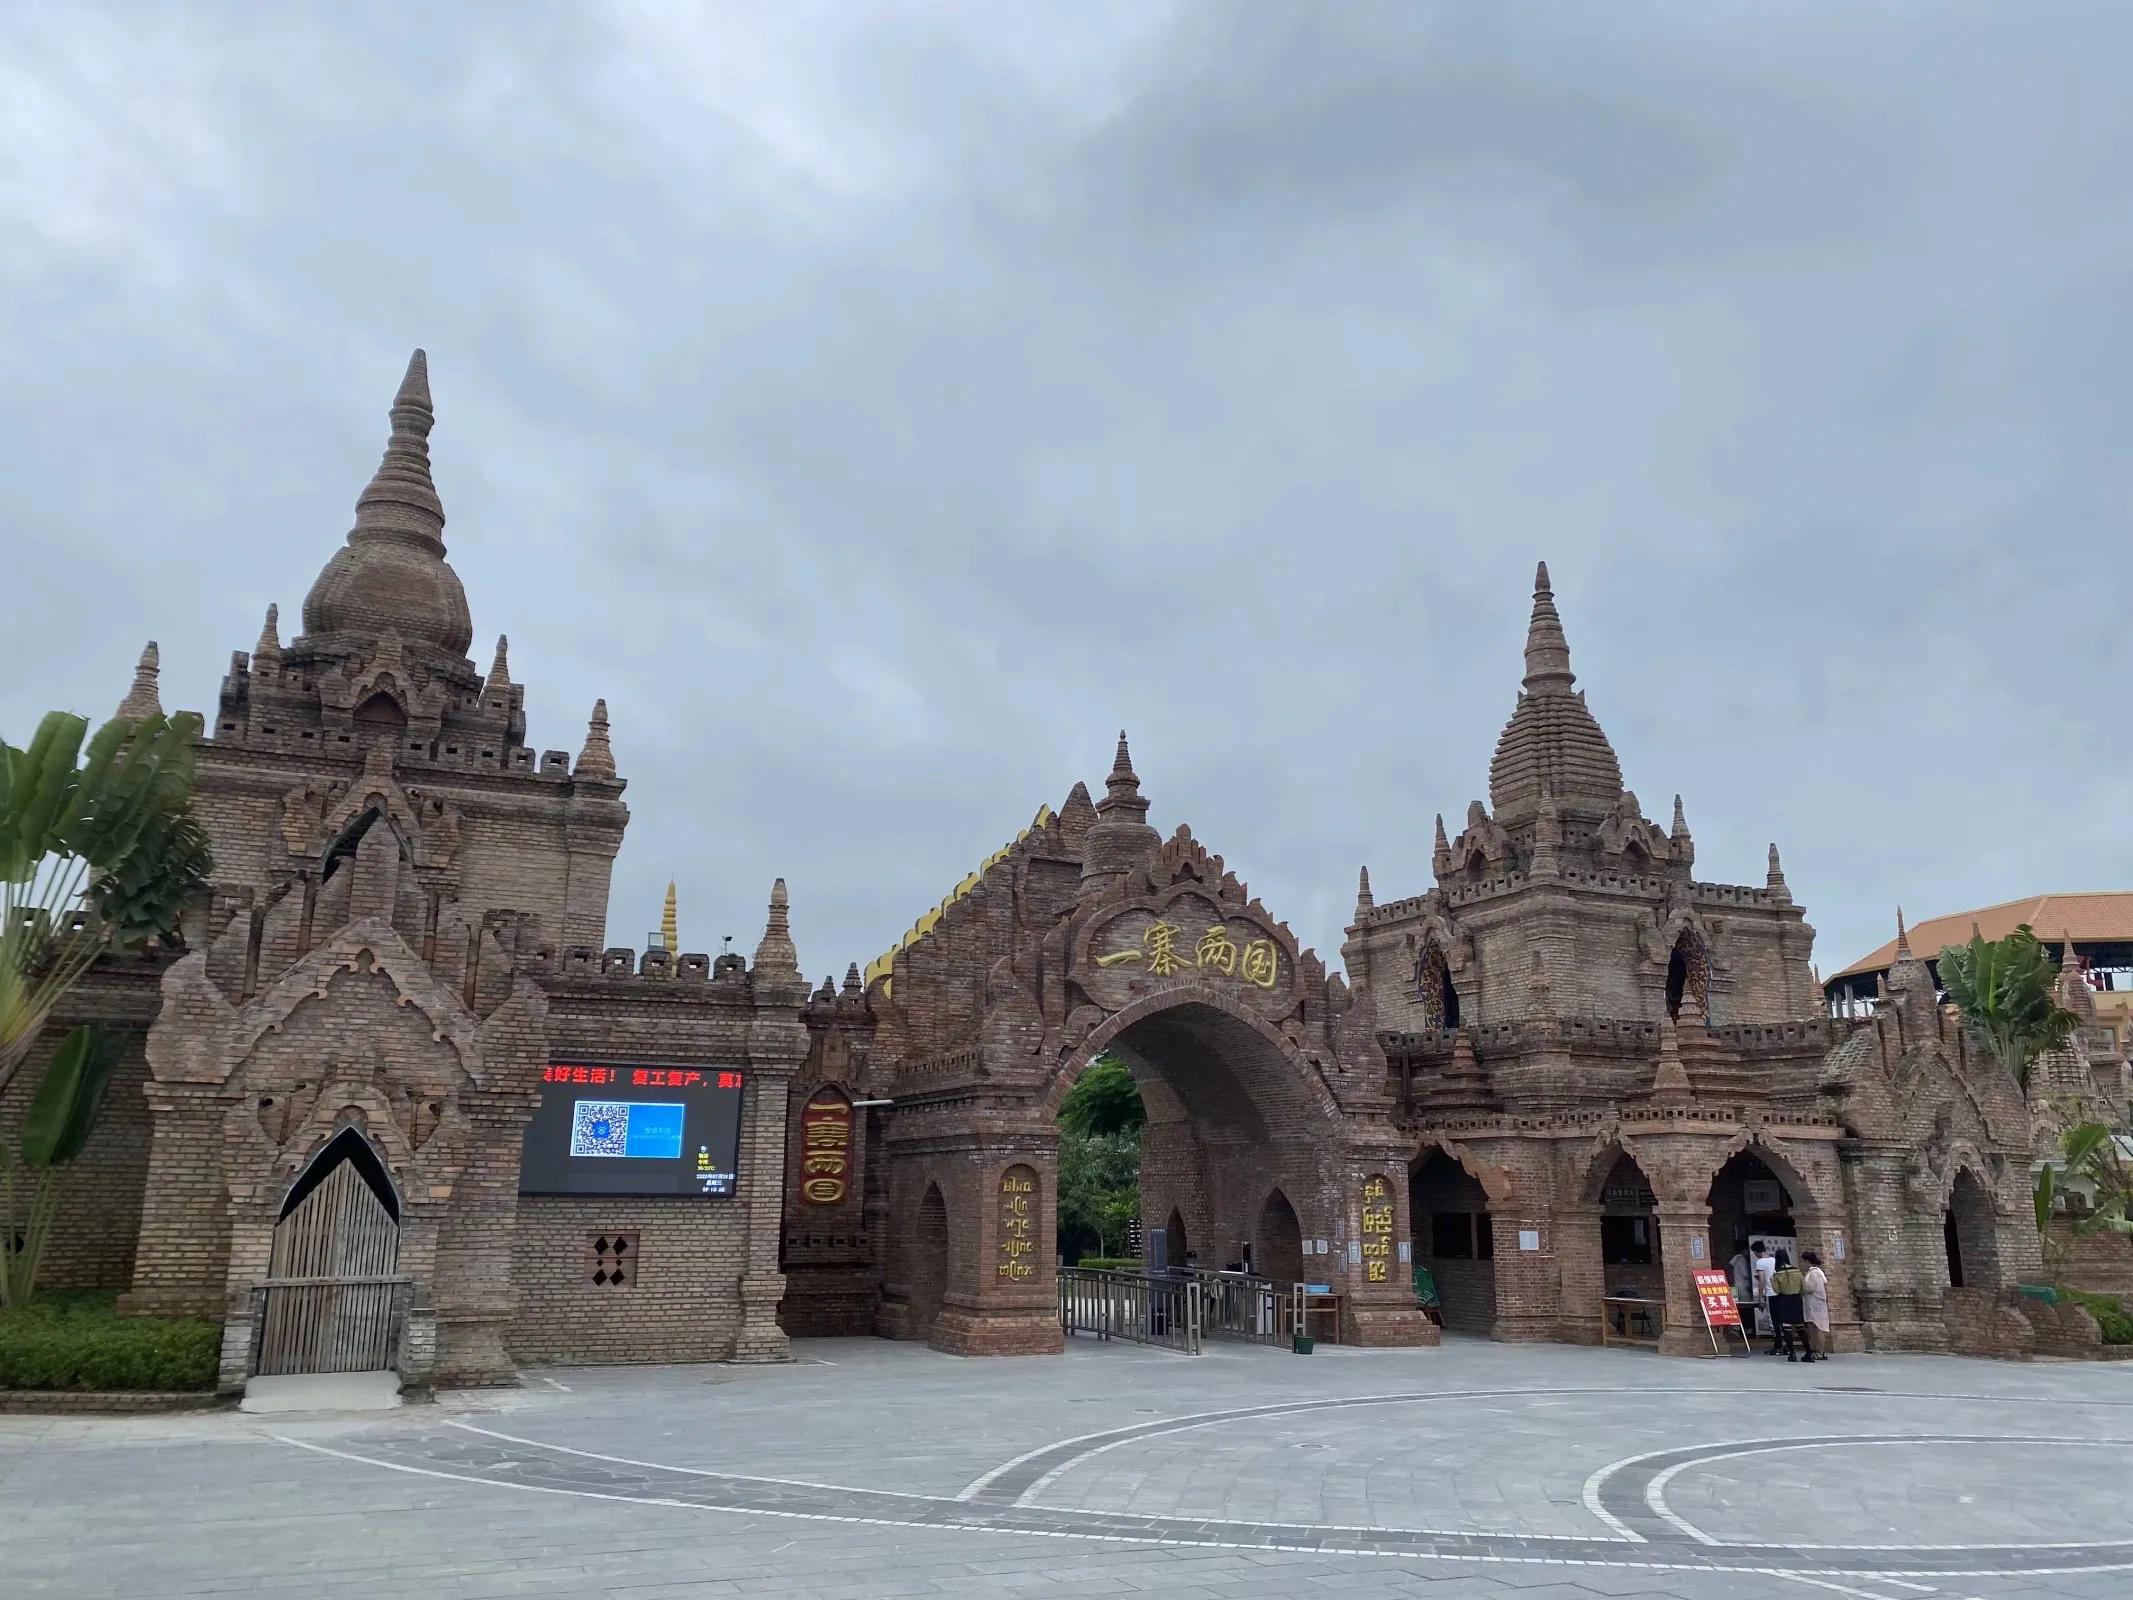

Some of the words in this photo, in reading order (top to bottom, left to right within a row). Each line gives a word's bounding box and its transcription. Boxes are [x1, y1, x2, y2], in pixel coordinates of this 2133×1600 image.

[1095, 919, 1278, 989] 一寨两国
[1696, 1274, 1727, 1285] 疫情期间
[1706, 1295, 1731, 1308] 买票
